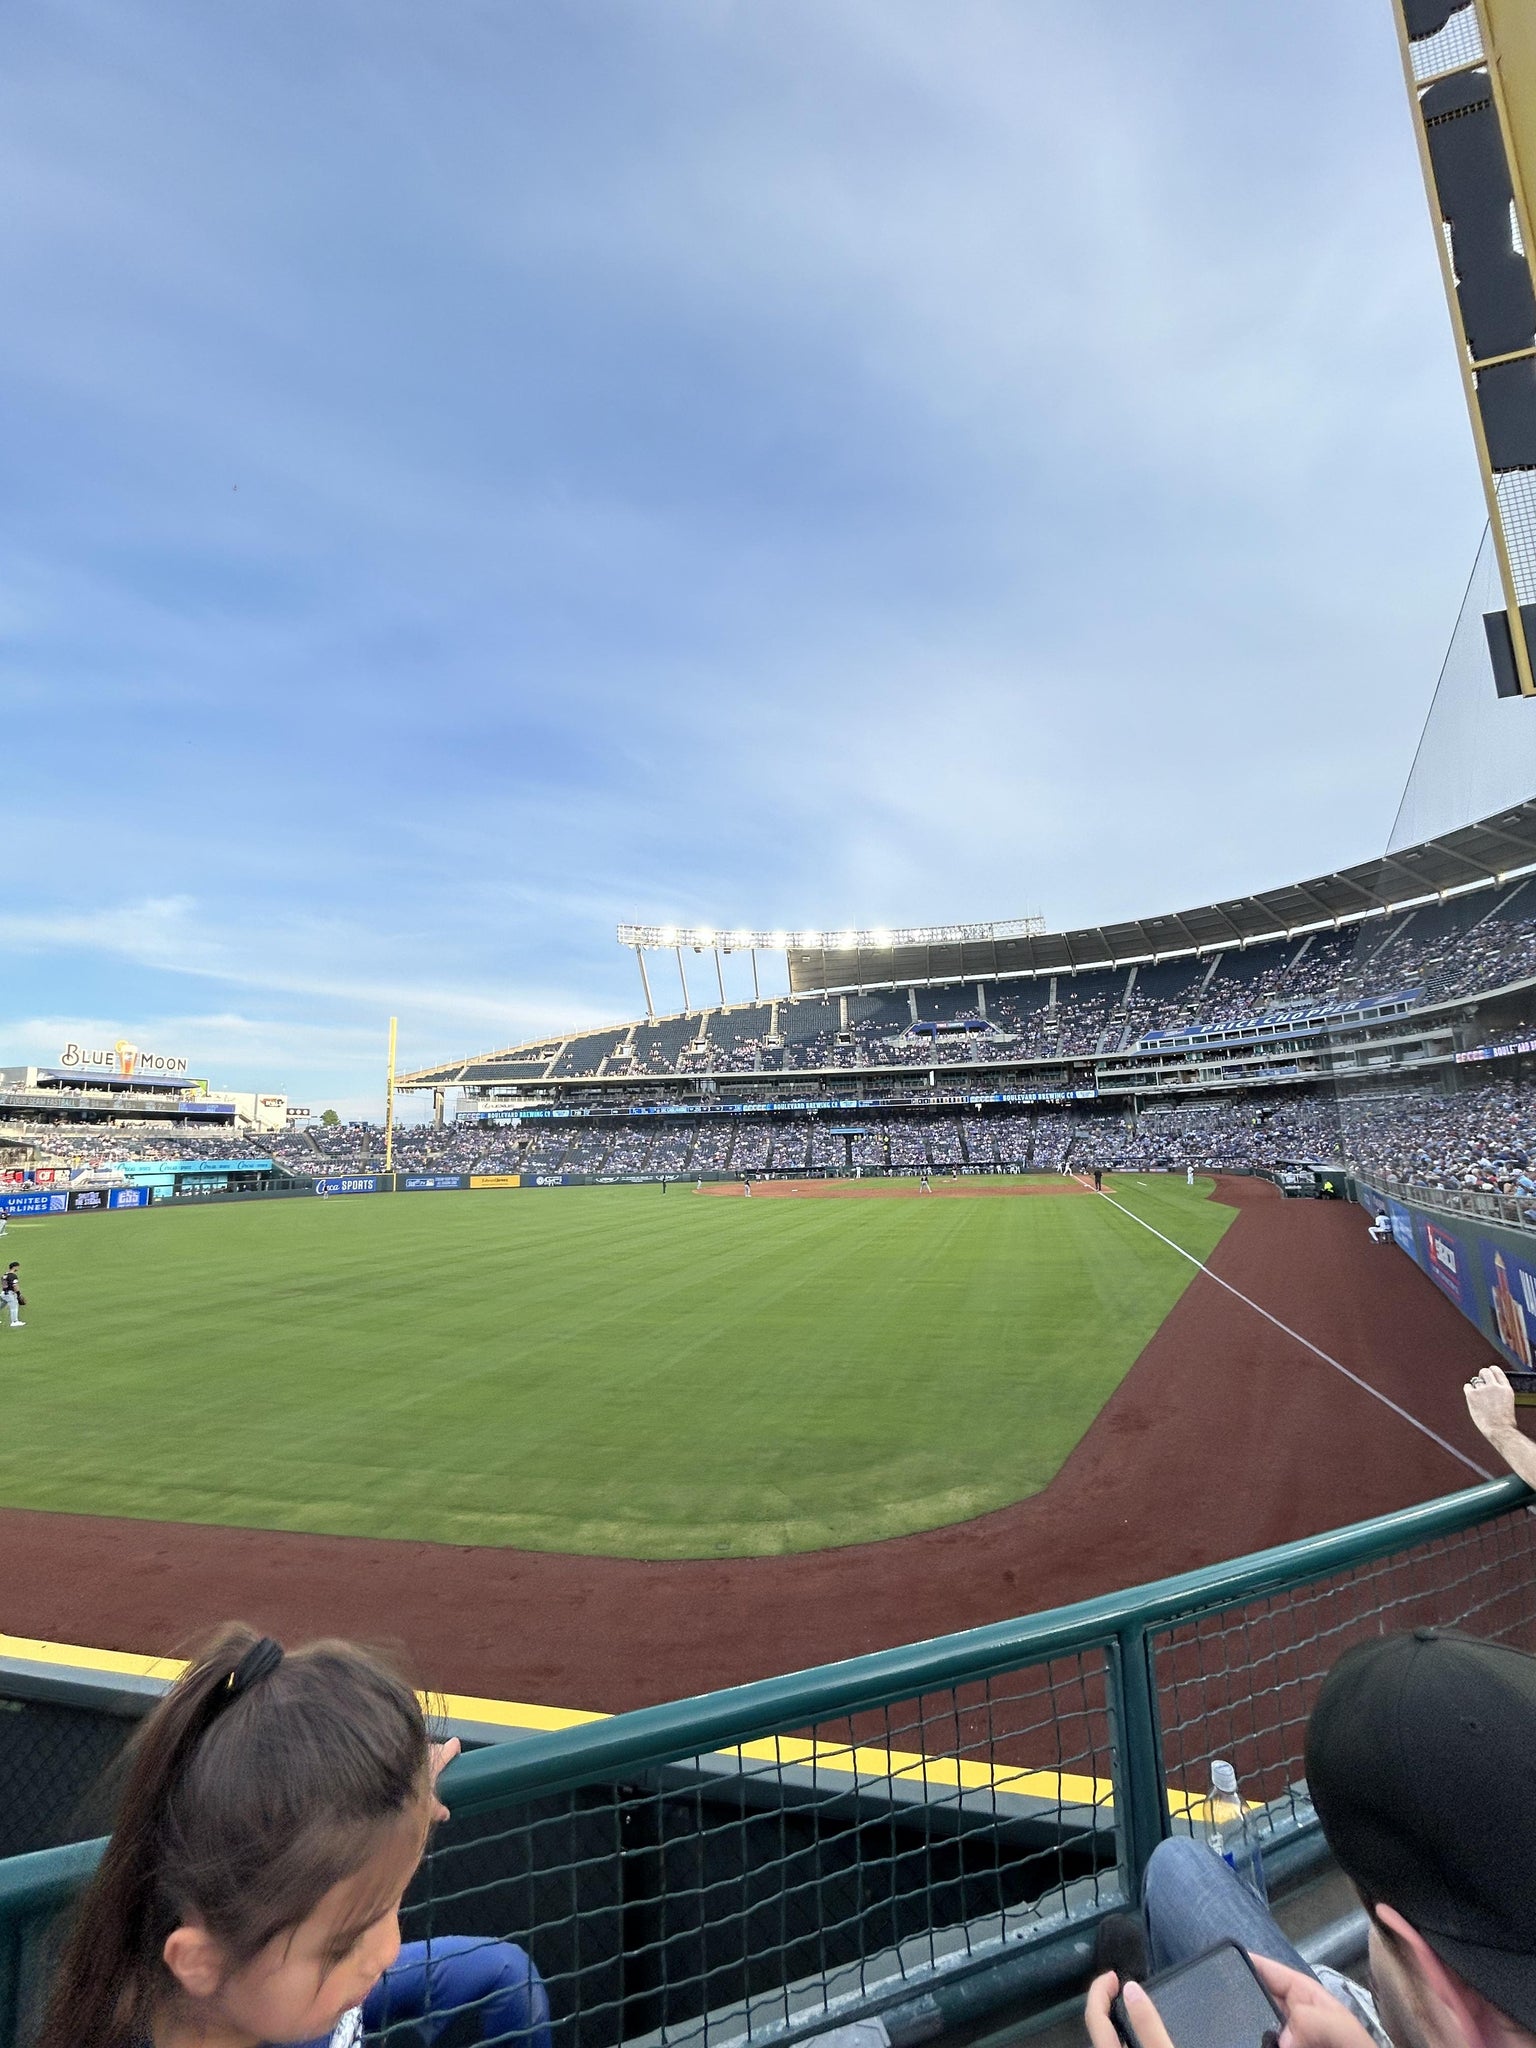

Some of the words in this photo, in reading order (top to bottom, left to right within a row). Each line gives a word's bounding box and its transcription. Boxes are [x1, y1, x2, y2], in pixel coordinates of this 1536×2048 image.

[1200, 1020, 1257, 1032] PRICE
[1263, 1002, 1360, 1024] CHOPPER
[61, 1043, 114, 1066] BLUE
[141, 1053, 187, 1070] MOON
[1038, 1092, 1065, 1100] BREWING
[774, 1102, 804, 1110] BOULEVARD
[806, 1101, 830, 1109] BREWING
[341, 1179, 374, 1191] SPORTS
[8, 1197, 48, 1205] UNITED
